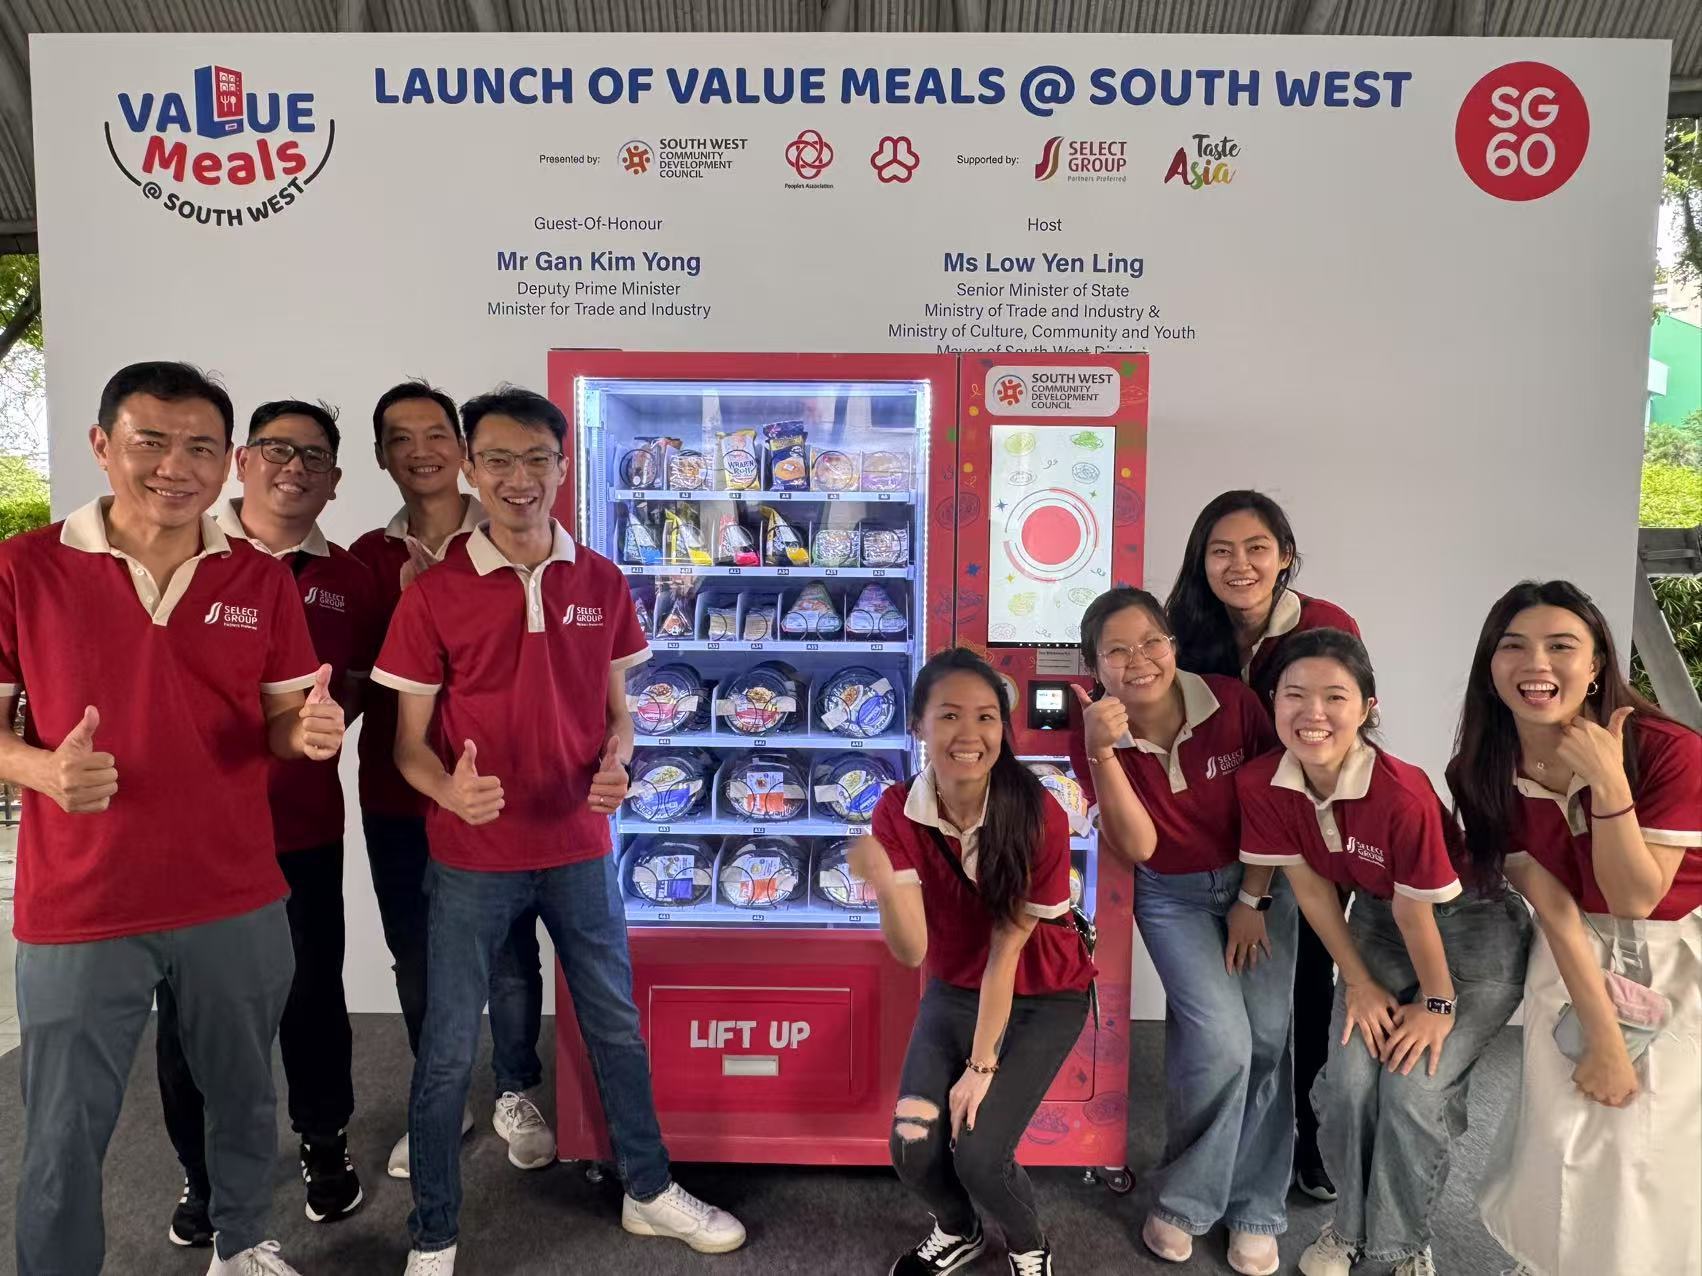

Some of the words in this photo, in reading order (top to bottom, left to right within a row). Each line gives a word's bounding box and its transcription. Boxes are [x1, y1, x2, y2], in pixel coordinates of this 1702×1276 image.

[375, 67, 572, 104] LAUNCH
[589, 67, 653, 104] OF
[666, 68, 825, 104] VALUE
[841, 67, 1005, 104] MEALS
[1020, 66, 1075, 117] @
[1090, 68, 1259, 106] SOUTH
[1276, 71, 1412, 108] WEST
[117, 65, 316, 139] VALUE
[1488, 86, 1559, 128] SG
[660, 139, 706, 149] SOUTH
[710, 139, 747, 149] WEST
[1069, 141, 1127, 156] SELECT
[1192, 134, 1241, 160] Taste
[142, 135, 306, 185] Meals
[539, 154, 585, 164] Presented
[587, 155, 601, 166] by:
[659, 151, 724, 160] COMMUNITY
[957, 154, 1003, 167] Supported
[1006, 155, 1020, 167] by:
[1486, 132, 1556, 176] 60
[660, 161, 732, 169] DEVELOPMENT
[1069, 158, 1126, 172] GROUP
[1164, 147, 1236, 190] Asia
[660, 170, 703, 178] COUNCIL
[142, 181, 162, 200] @
[163, 192, 243, 226] SOUTH
[246, 176, 305, 222] WEST
[535, 216, 662, 230] Guest-Of-Honour
[1028, 218, 1062, 231] Host
[498, 252, 528, 270] Mr
[536, 252, 582, 271] Gan
[591, 251, 635, 271] Kim
[642, 252, 700, 276] Yong
[945, 253, 978, 272] Ms
[986, 253, 1035, 272] Low
[1042, 253, 1083, 272] Yen
[1093, 253, 1143, 278] Ling
[518, 282, 570, 298] Deputy
[576, 281, 616, 295] Prime
[623, 281, 680, 295] Minister
[957, 282, 1004, 296] Senior
[1010, 283, 1069, 296] Minister
[1073, 283, 1087, 296] of
[1092, 284, 1129, 297] State
[488, 302, 546, 315] Minister
[550, 302, 570, 315] for
[574, 302, 614, 315] Trade
[620, 302, 646, 315] and
[652, 302, 710, 319] Industry
[926, 304, 983, 320] Ministry
[989, 304, 1002, 316] of
[1006, 304, 1046, 317] Trade
[1052, 304, 1078, 317] and
[1085, 304, 1144, 321] Industry
[1149, 305, 1160, 318] &
[889, 324, 947, 340] Ministry
[952, 324, 966, 337] of
[971, 324, 1026, 339] Culture,
[1033, 325, 1117, 342] Community
[1122, 325, 1149, 338] and
[1154, 326, 1195, 339] Youth
[1032, 374, 1075, 383] SOUTH
[1078, 374, 1113, 383] WEST
[1031, 385, 1091, 393] COMMUNITY
[224, 605, 258, 617] SELECT
[576, 606, 602, 615] SELECT
[576, 614, 603, 622] GROUP
[224, 614, 258, 624] GROUP
[1217, 749, 1243, 764] SELECT
[690, 1020, 757, 1048] LIFT
[769, 1020, 811, 1049] UP
